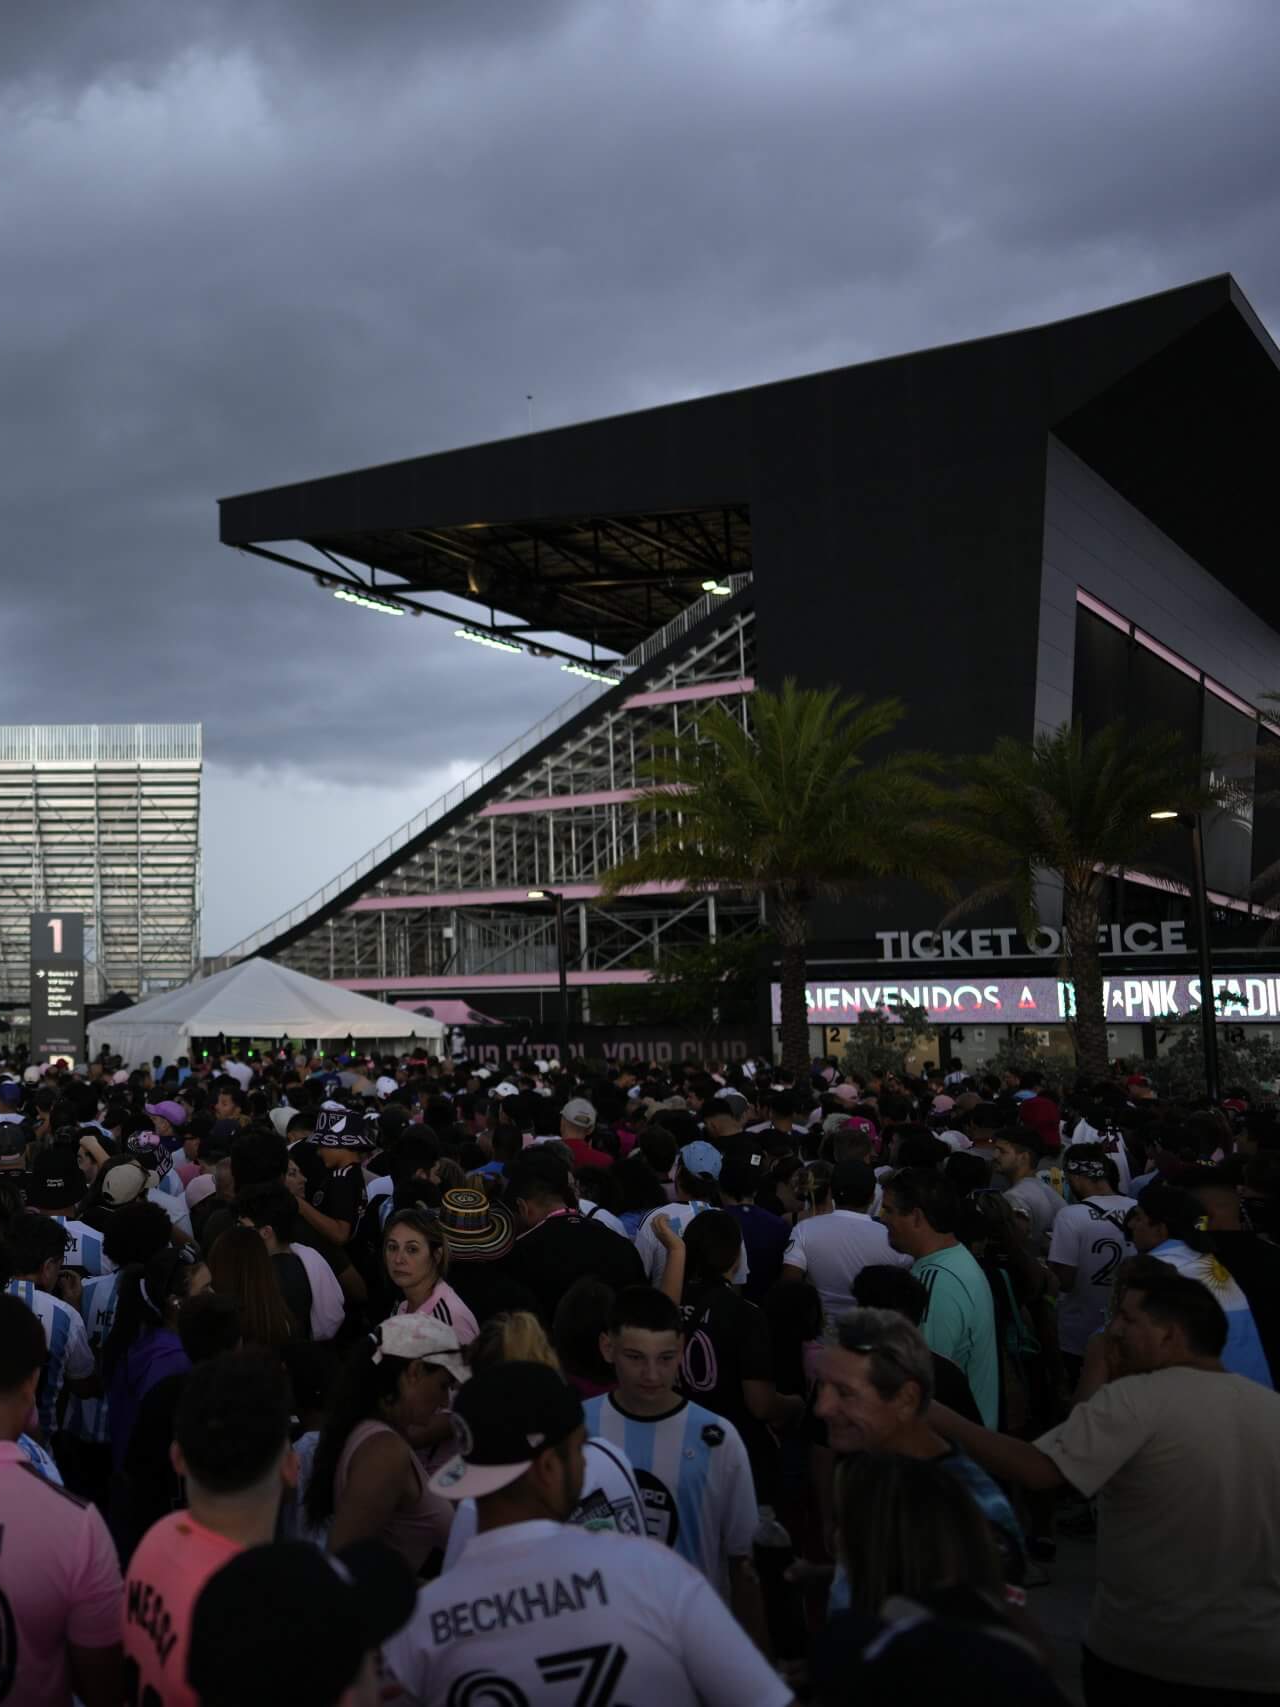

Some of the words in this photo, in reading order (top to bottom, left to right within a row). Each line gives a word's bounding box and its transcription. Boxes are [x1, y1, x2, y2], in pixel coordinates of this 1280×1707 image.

[47, 918, 63, 954] 1
[875, 927, 1017, 961] TICKET
[1019, 986, 1037, 1009] A
[1123, 980, 1179, 1017] PNK
[127, 1580, 178, 1666] MESSI
[429, 1567, 609, 1645] BECKHAM
